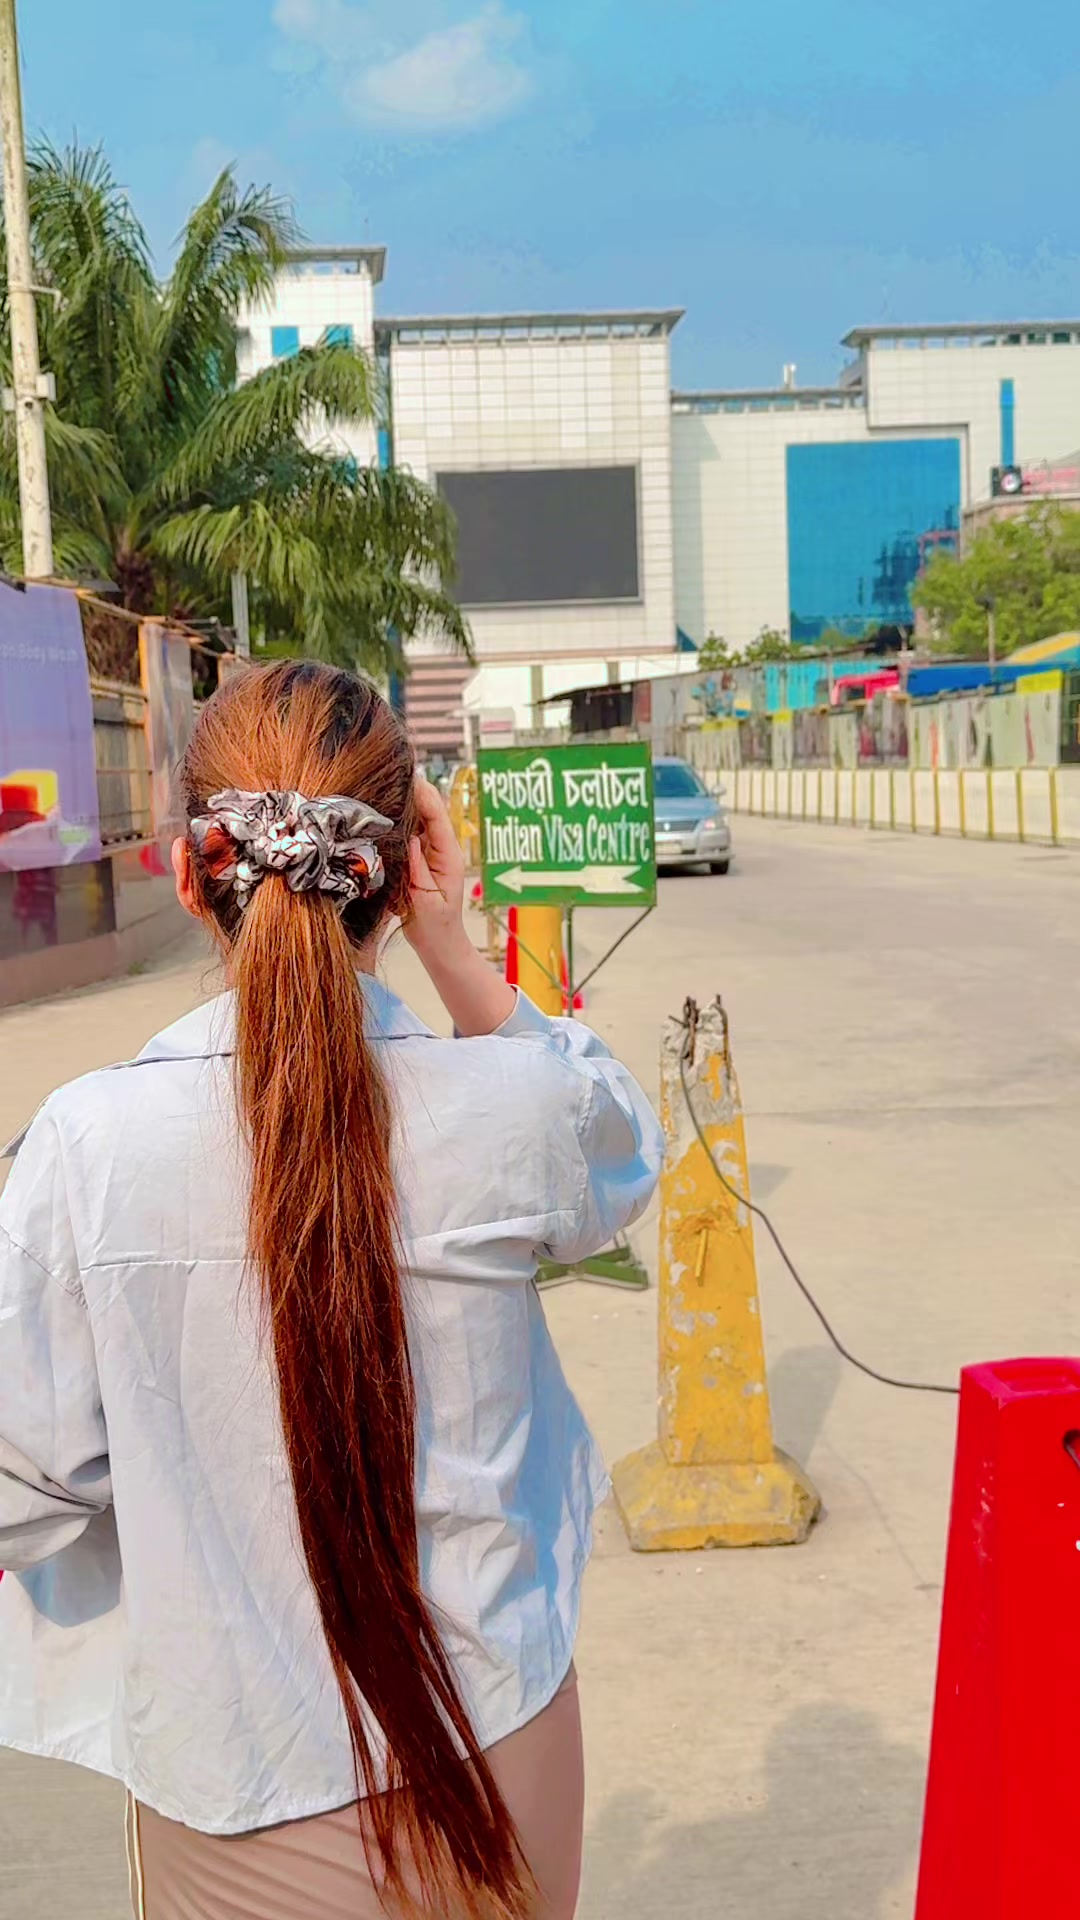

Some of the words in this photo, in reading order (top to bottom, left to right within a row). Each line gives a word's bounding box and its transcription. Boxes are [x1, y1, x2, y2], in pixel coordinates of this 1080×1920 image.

[482, 758, 553, 814] পথচারী
[562, 762, 647, 809] চলাচল
[485, 816, 543, 863] Indian
[543, 815, 585, 862] Visa
